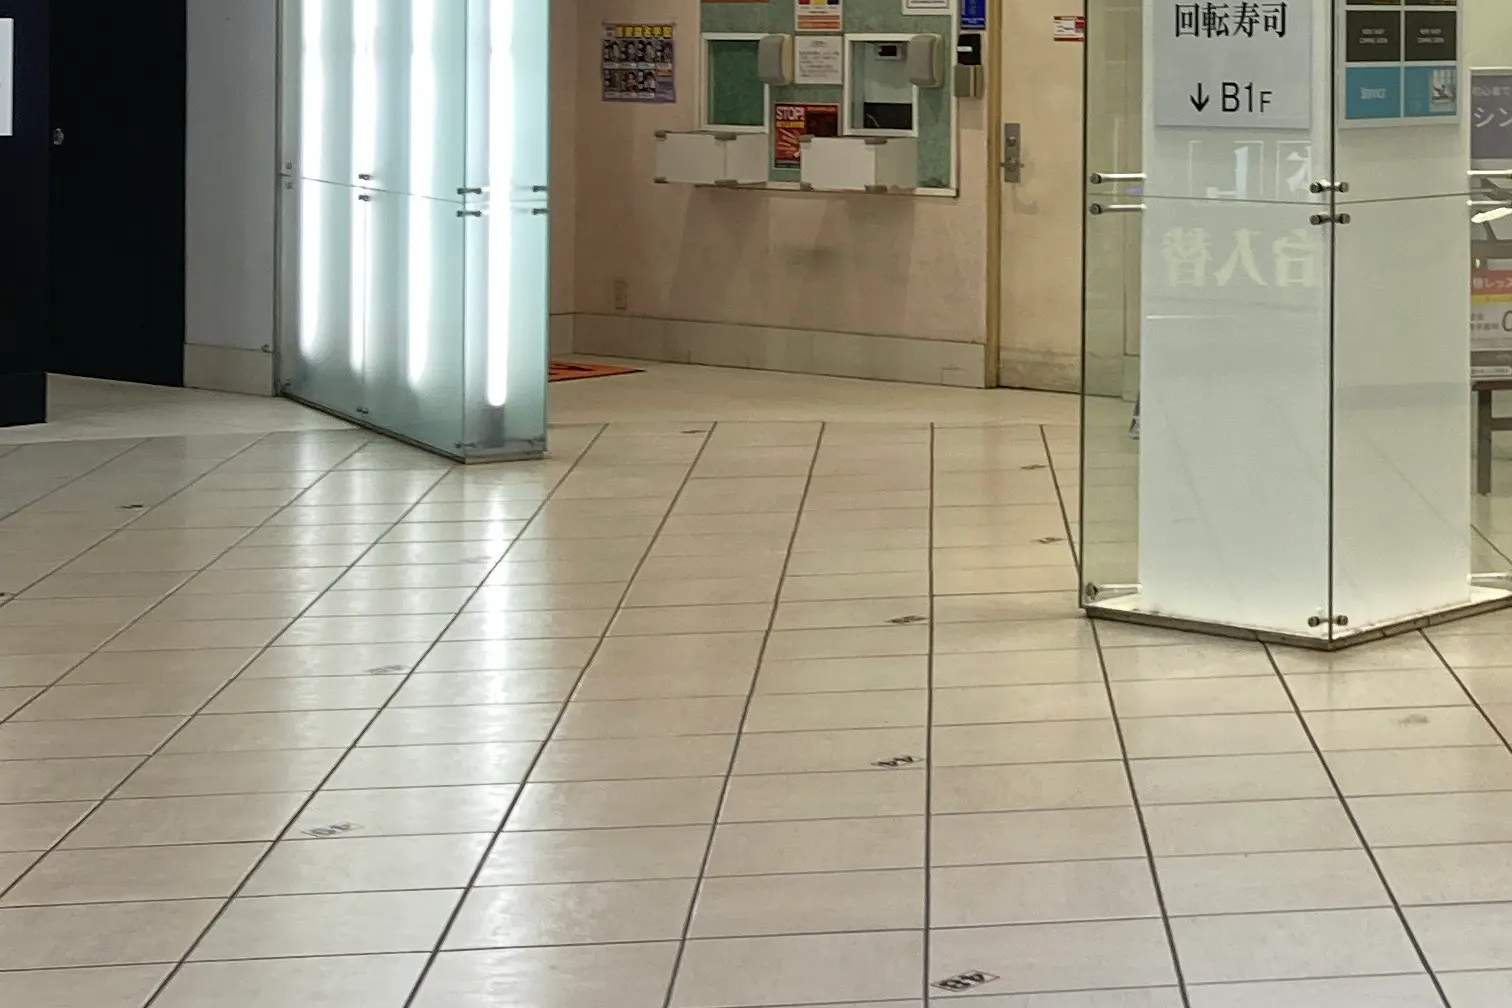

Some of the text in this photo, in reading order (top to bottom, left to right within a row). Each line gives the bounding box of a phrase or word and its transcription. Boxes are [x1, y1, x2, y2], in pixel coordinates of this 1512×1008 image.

[1175, 1, 1287, 38] 回転寿司
[1222, 82, 1272, 113] B1F
